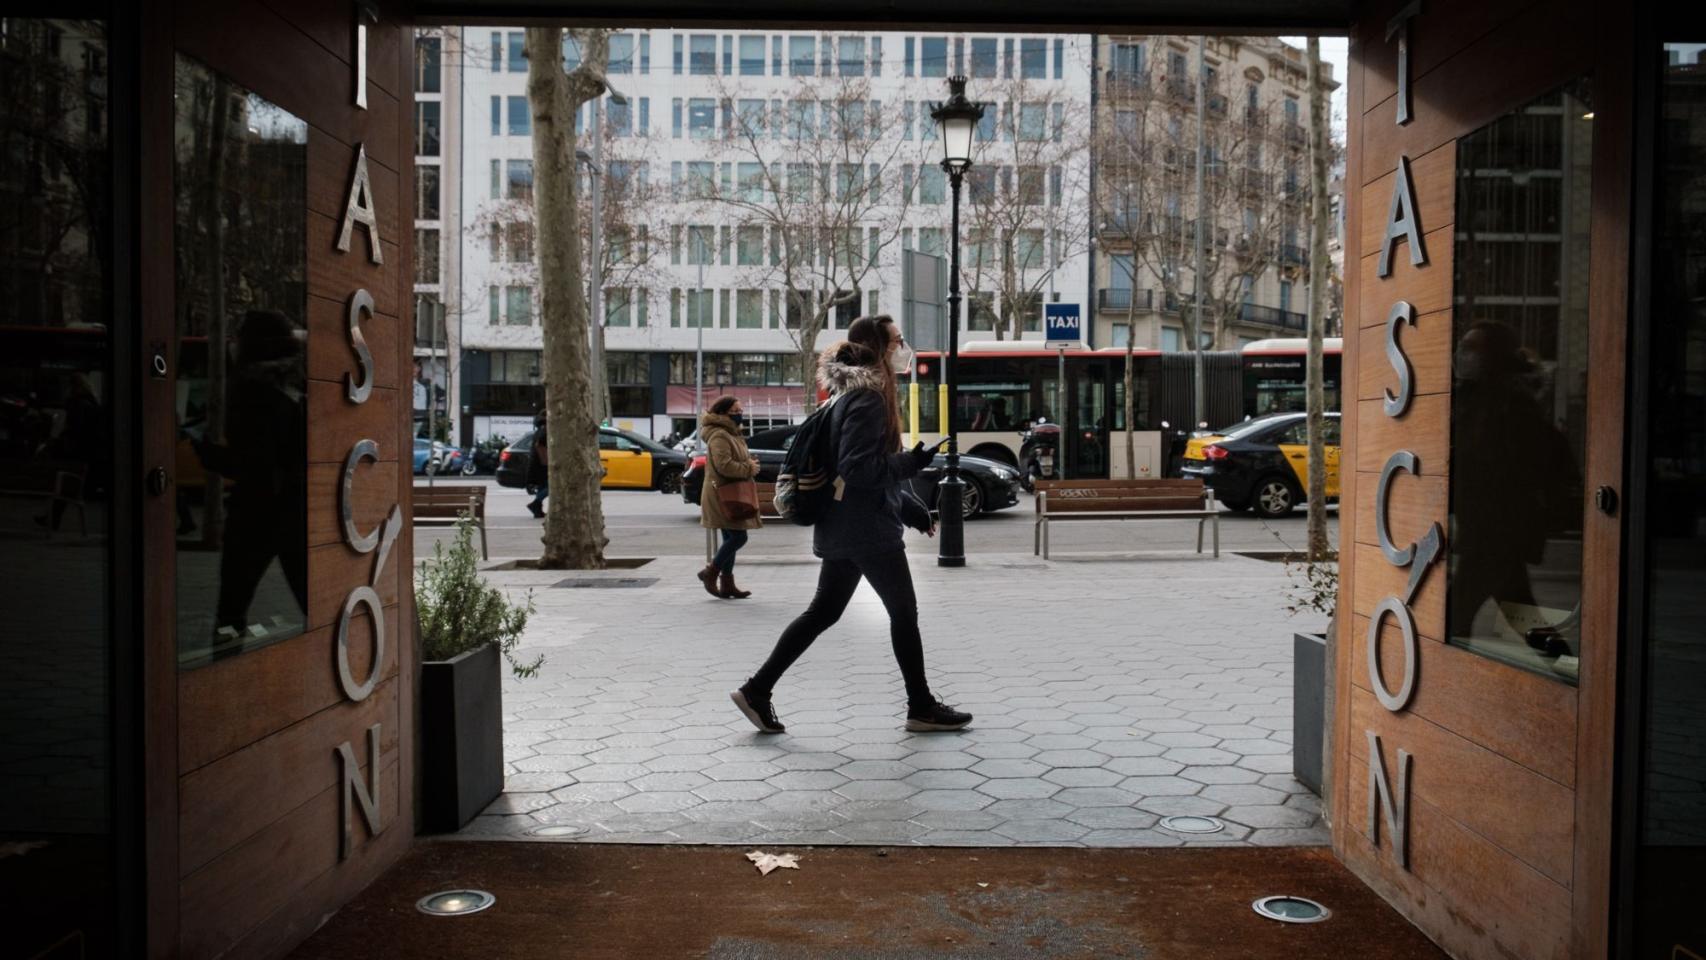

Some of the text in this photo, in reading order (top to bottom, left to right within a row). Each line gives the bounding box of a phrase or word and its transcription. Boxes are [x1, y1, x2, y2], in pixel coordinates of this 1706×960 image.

[334, 0, 402, 860] TASCÓN
[1047, 316, 1079, 329] TAXI
[1366, 0, 1445, 870] TASCÓN
